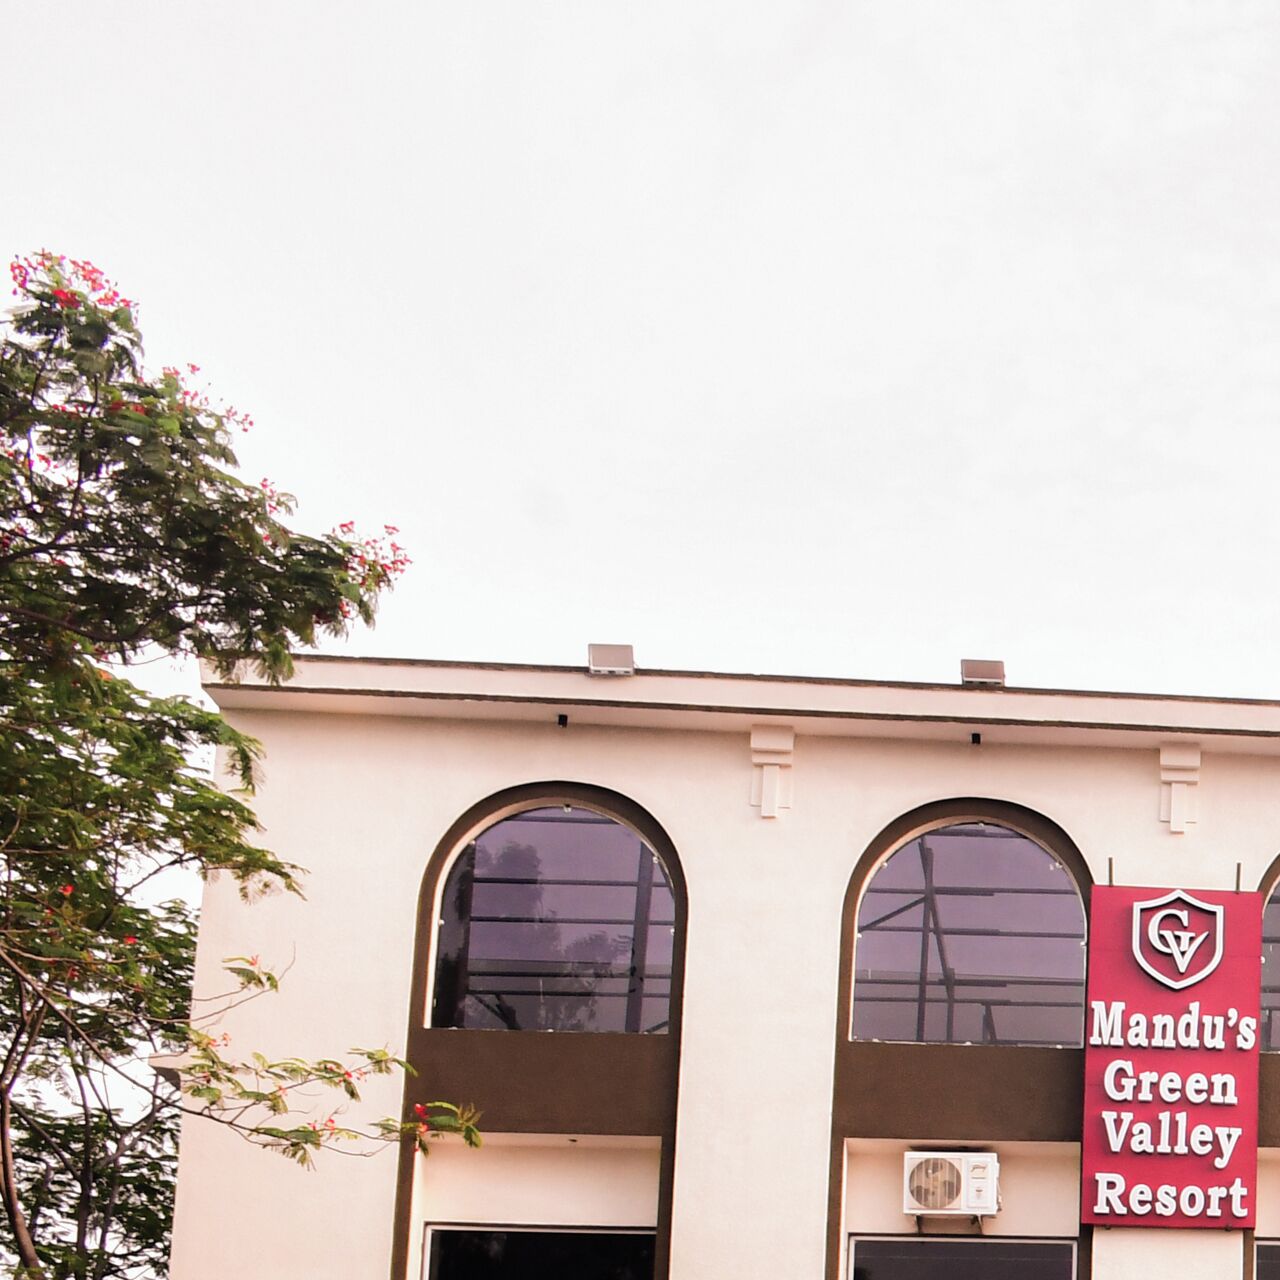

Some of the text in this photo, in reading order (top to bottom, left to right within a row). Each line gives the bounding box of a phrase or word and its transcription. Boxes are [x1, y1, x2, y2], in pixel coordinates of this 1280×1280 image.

[1089, 1000, 1257, 1050] Mandu's
[1103, 1059, 1238, 1105] Green
[1101, 1110, 1243, 1169] Valley
[1093, 1172, 1248, 1217] Resort
